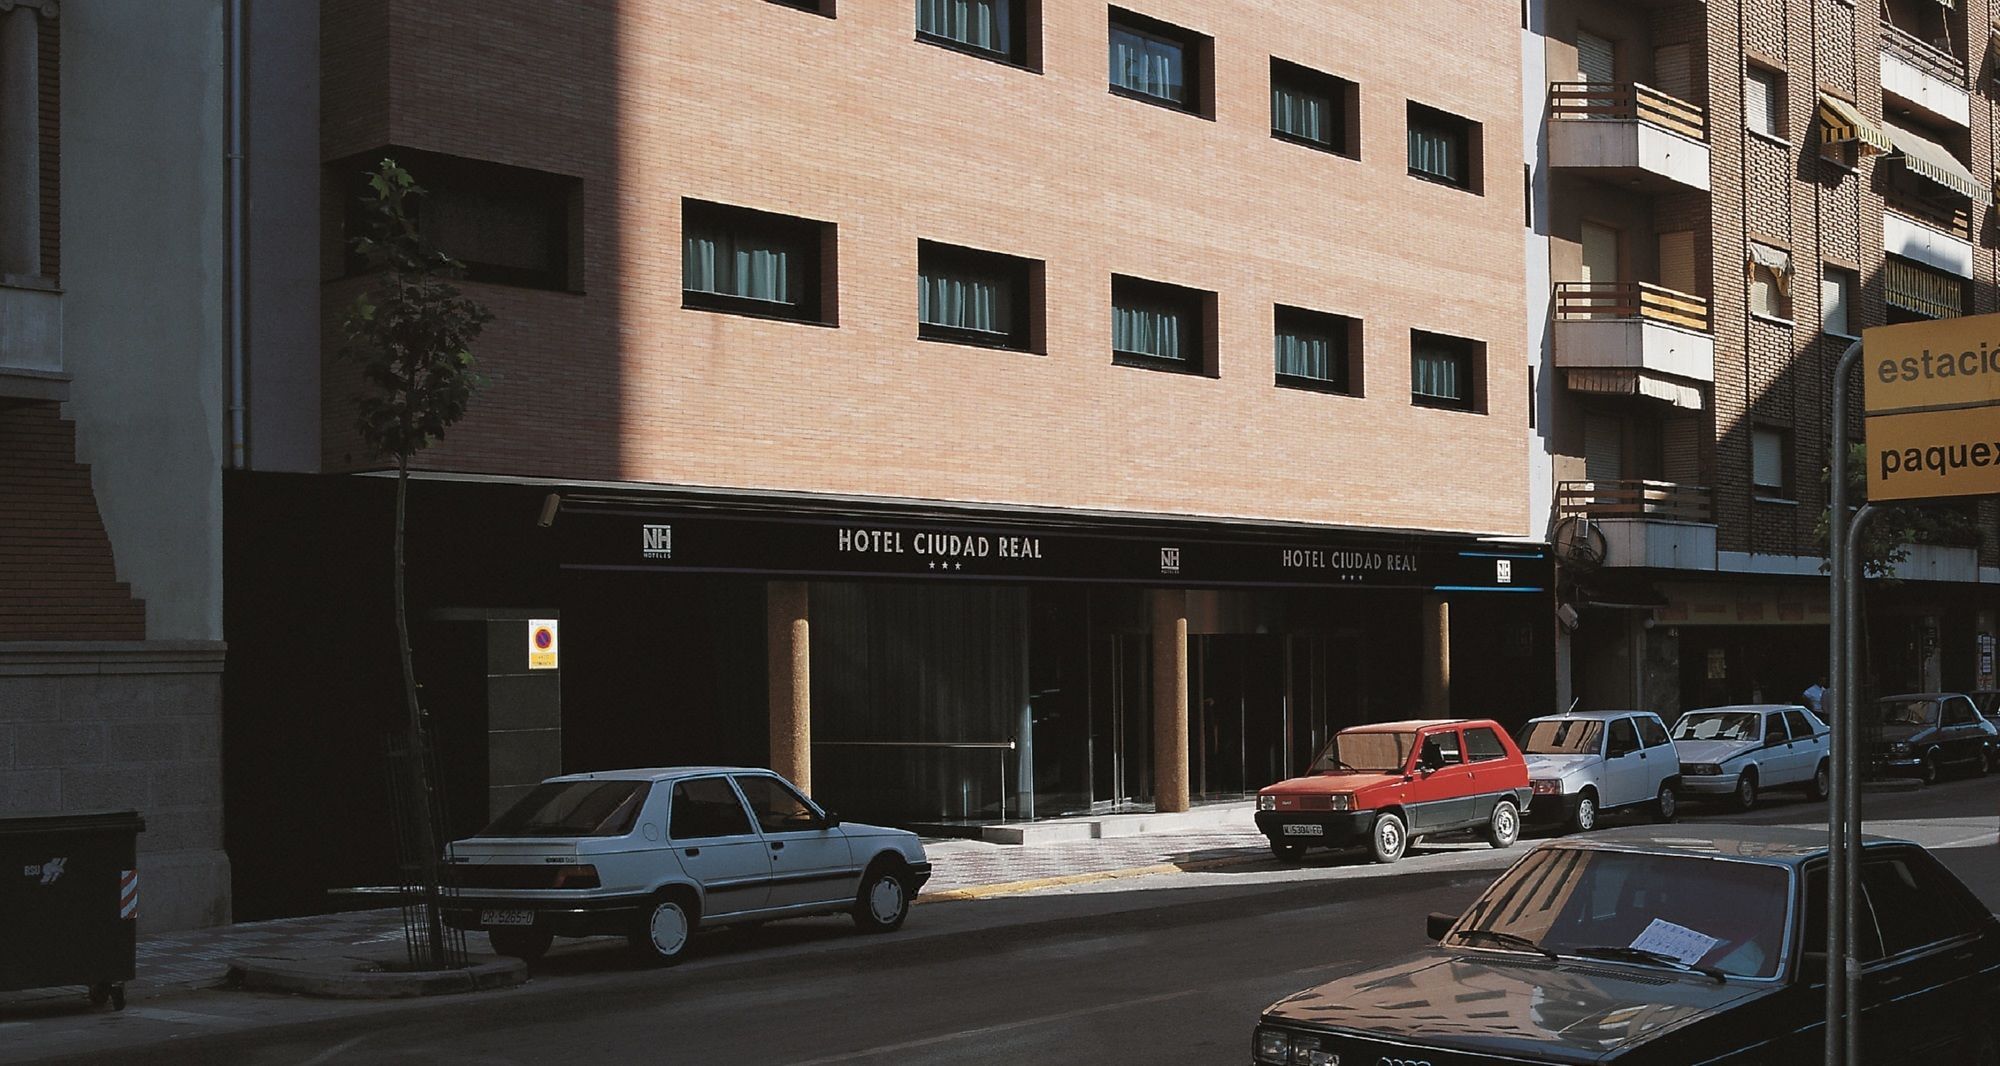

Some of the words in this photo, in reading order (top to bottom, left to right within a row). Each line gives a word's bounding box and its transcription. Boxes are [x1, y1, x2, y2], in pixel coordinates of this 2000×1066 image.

[643, 528, 671, 549] NH
[839, 529, 904, 553] HOTEL
[914, 533, 989, 557] CIUDAD
[999, 537, 1042, 559] REAL
[1161, 550, 1179, 566] NH
[1283, 550, 1325, 568] HOTEL
[1332, 551, 1381, 570] CIUDAD
[1387, 554, 1417, 571] REAL
